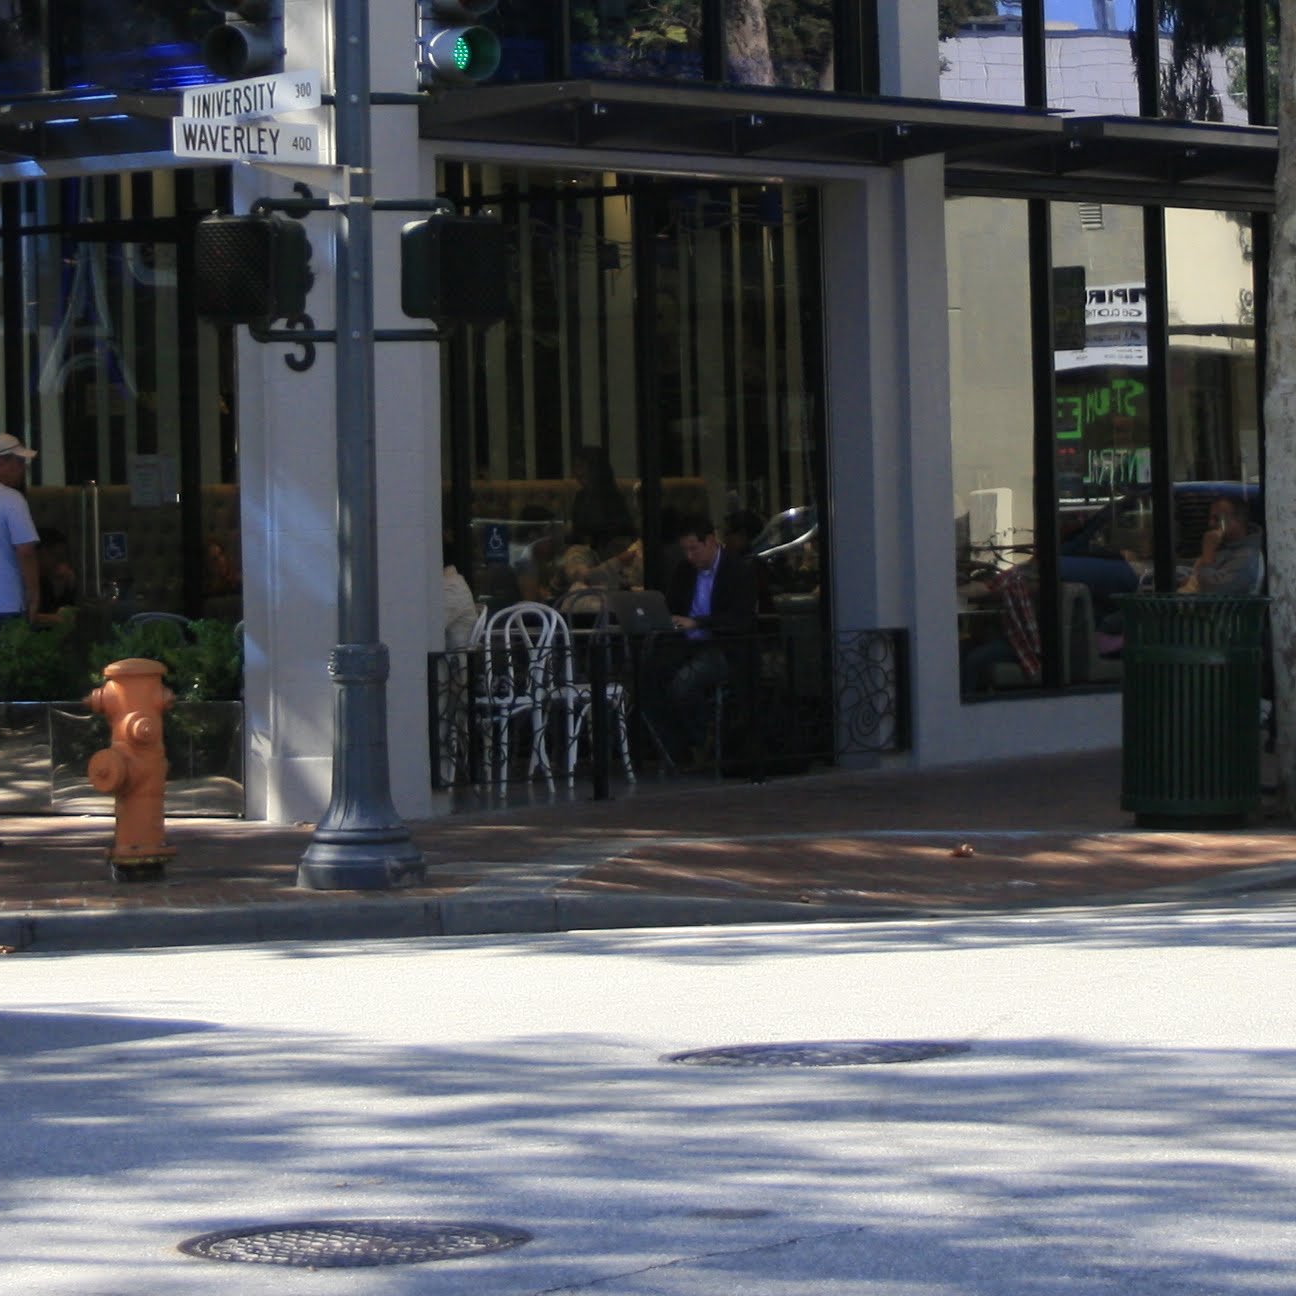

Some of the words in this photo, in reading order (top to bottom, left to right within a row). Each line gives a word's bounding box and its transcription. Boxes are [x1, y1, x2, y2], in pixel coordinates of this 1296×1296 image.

[192, 81, 277, 119] UNIVERSITY
[295, 82, 312, 99] 300
[183, 124, 280, 155] WAVERLEY
[292, 136, 312, 151] 400
